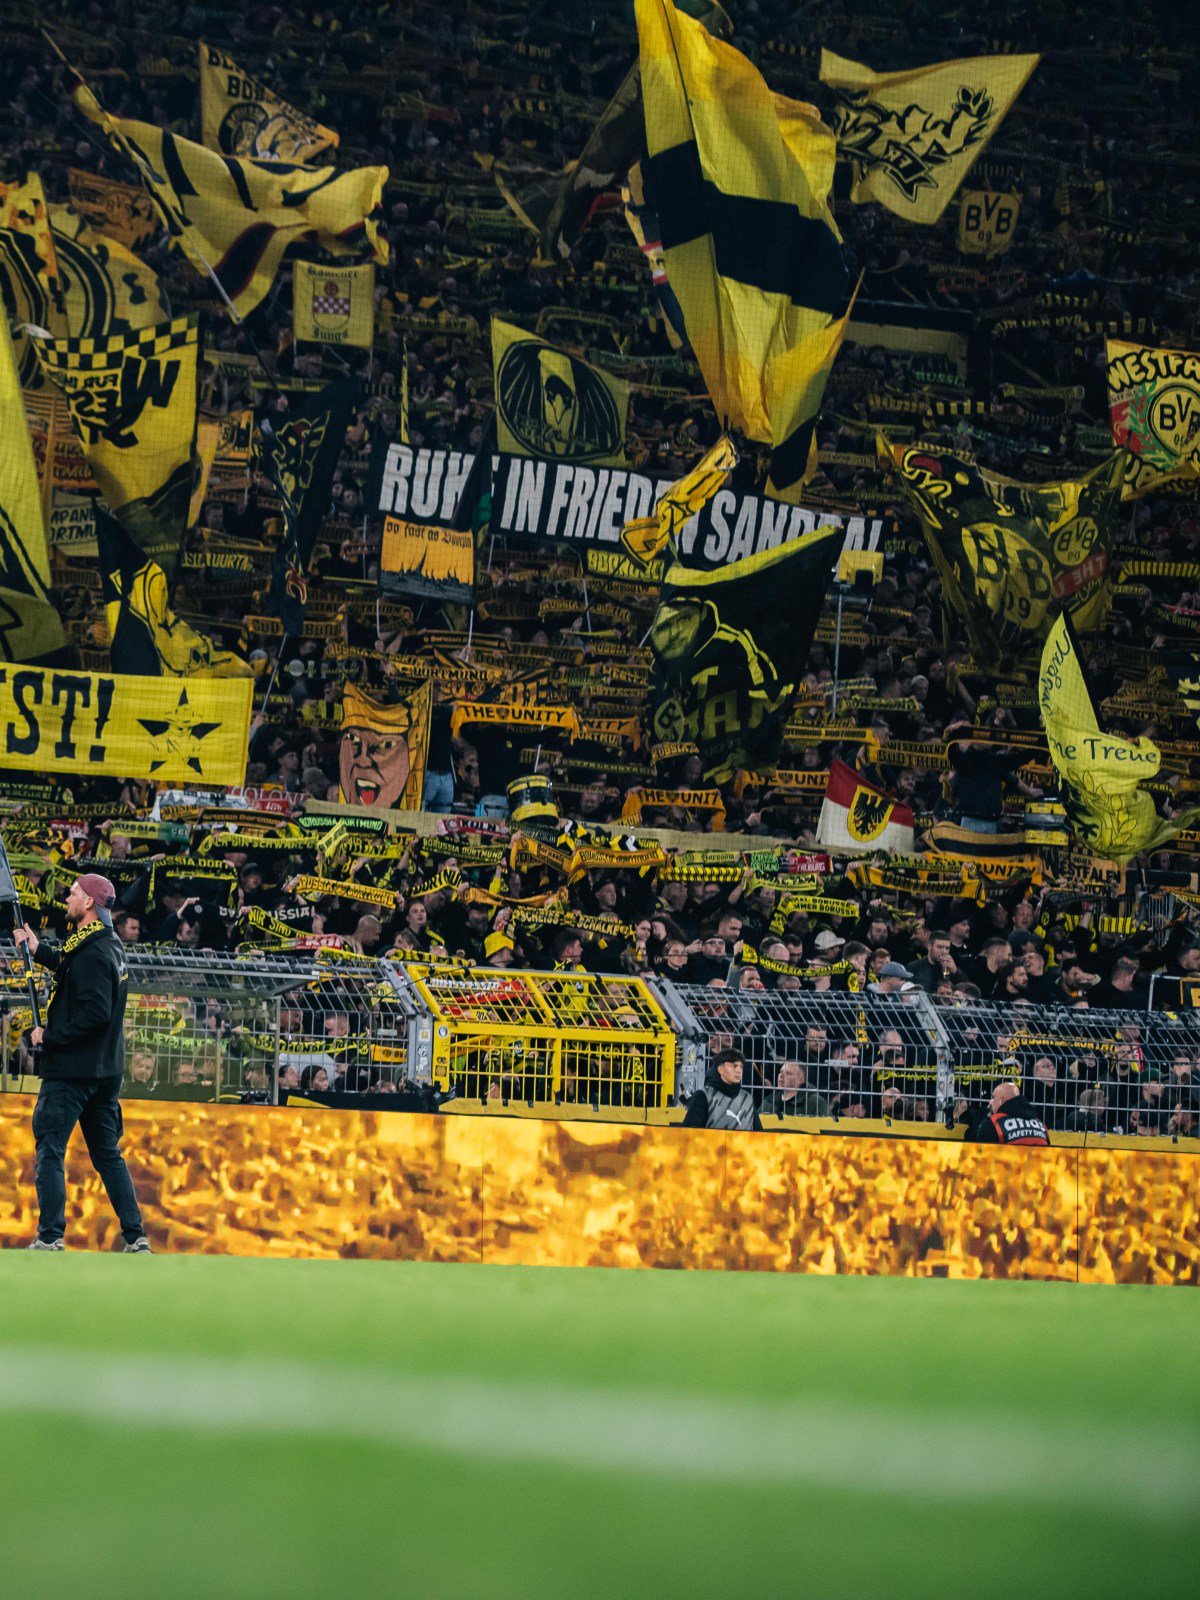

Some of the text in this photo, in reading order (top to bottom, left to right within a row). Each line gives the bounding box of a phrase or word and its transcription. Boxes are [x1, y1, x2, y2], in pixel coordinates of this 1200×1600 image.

[966, 194, 1013, 233] BVB
[501, 456, 541, 533] IN
[546, 463, 700, 556] FRIEDN
[462, 705, 567, 723] THE UNITY
[1084, 738, 1157, 764] Treue
[640, 789, 670, 805] THE
[22, 801, 134, 818] SUPER BORUSSIA
[1008, 1131, 1032, 1140] SAFETY
